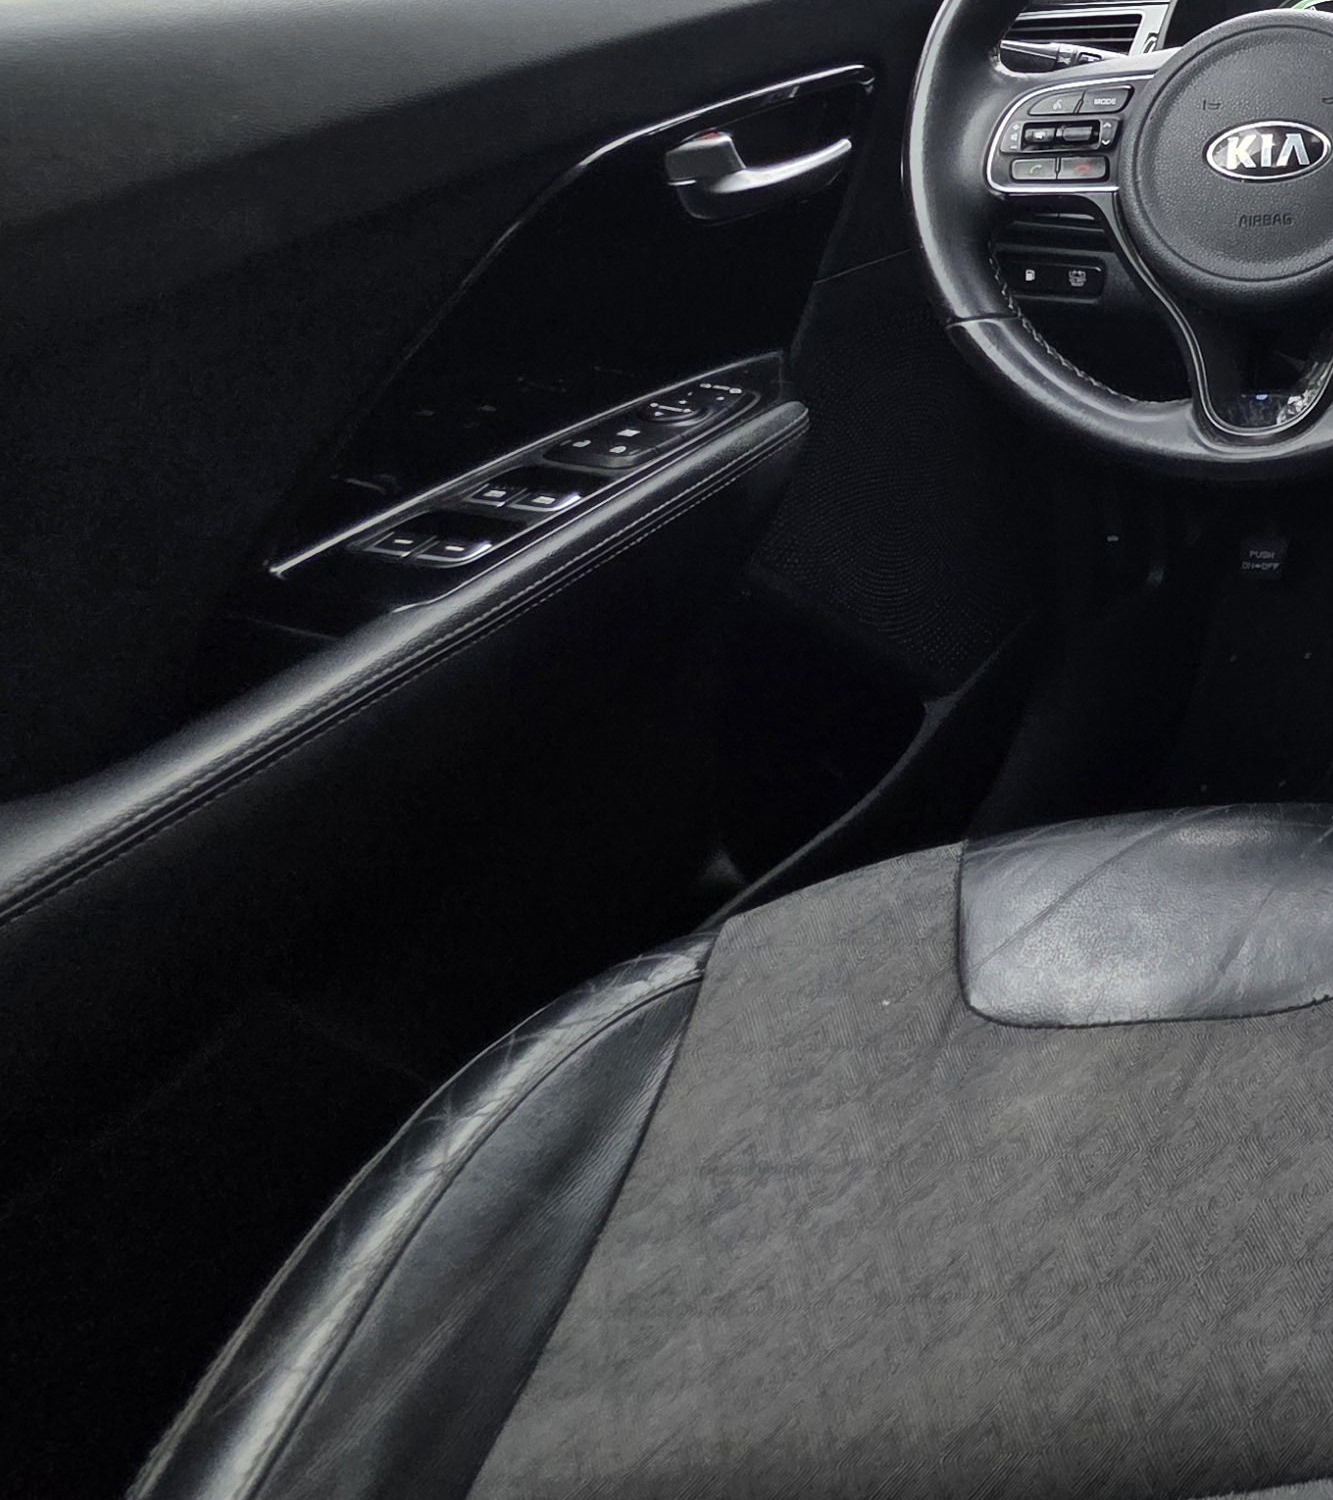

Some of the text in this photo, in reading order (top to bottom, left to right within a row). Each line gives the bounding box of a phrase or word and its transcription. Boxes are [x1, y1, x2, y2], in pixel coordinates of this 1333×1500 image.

[1225, 133, 1311, 171] KIA
[1238, 212, 1293, 228] AIRBAG
[1249, 550, 1275, 560] PUSH
